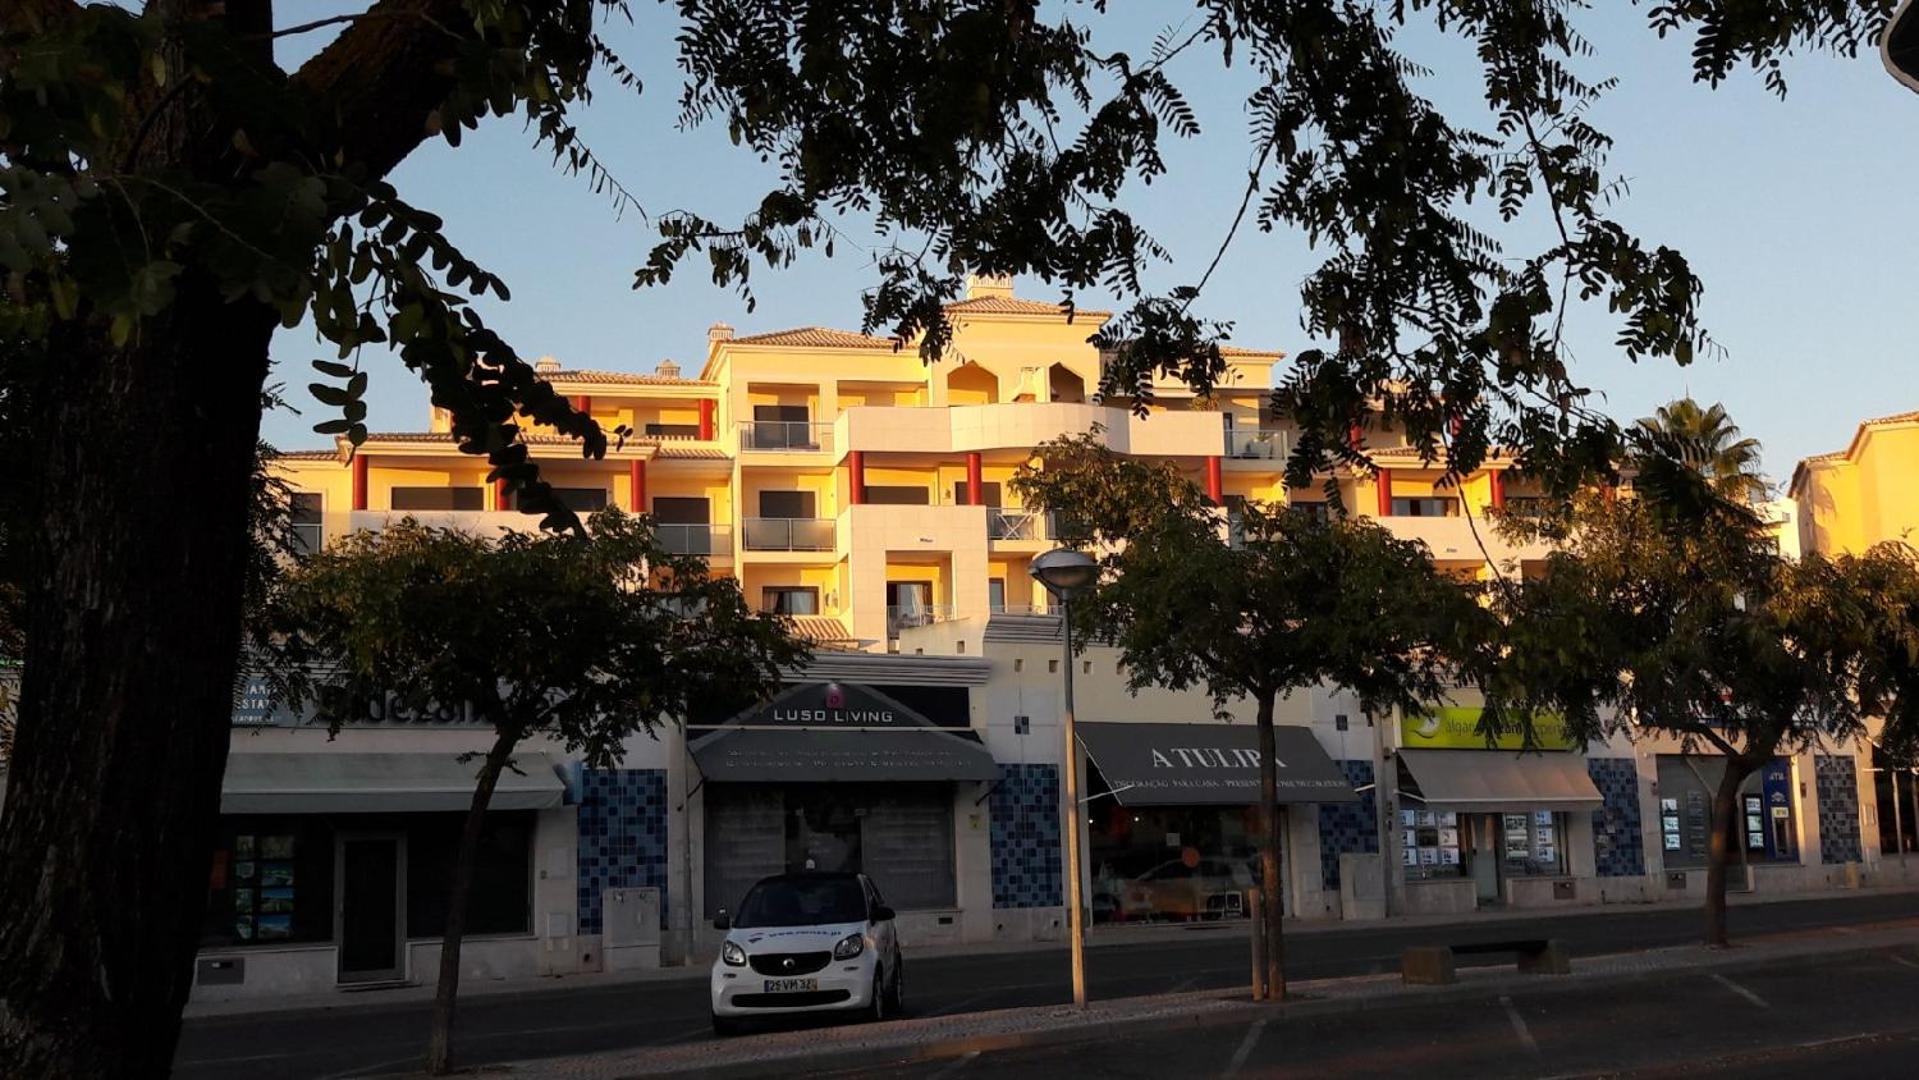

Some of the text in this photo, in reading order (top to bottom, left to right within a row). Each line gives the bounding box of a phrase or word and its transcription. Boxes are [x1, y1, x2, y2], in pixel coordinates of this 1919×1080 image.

[774, 709, 893, 724] LUSO LIVING
[1152, 748, 1173, 767] A
